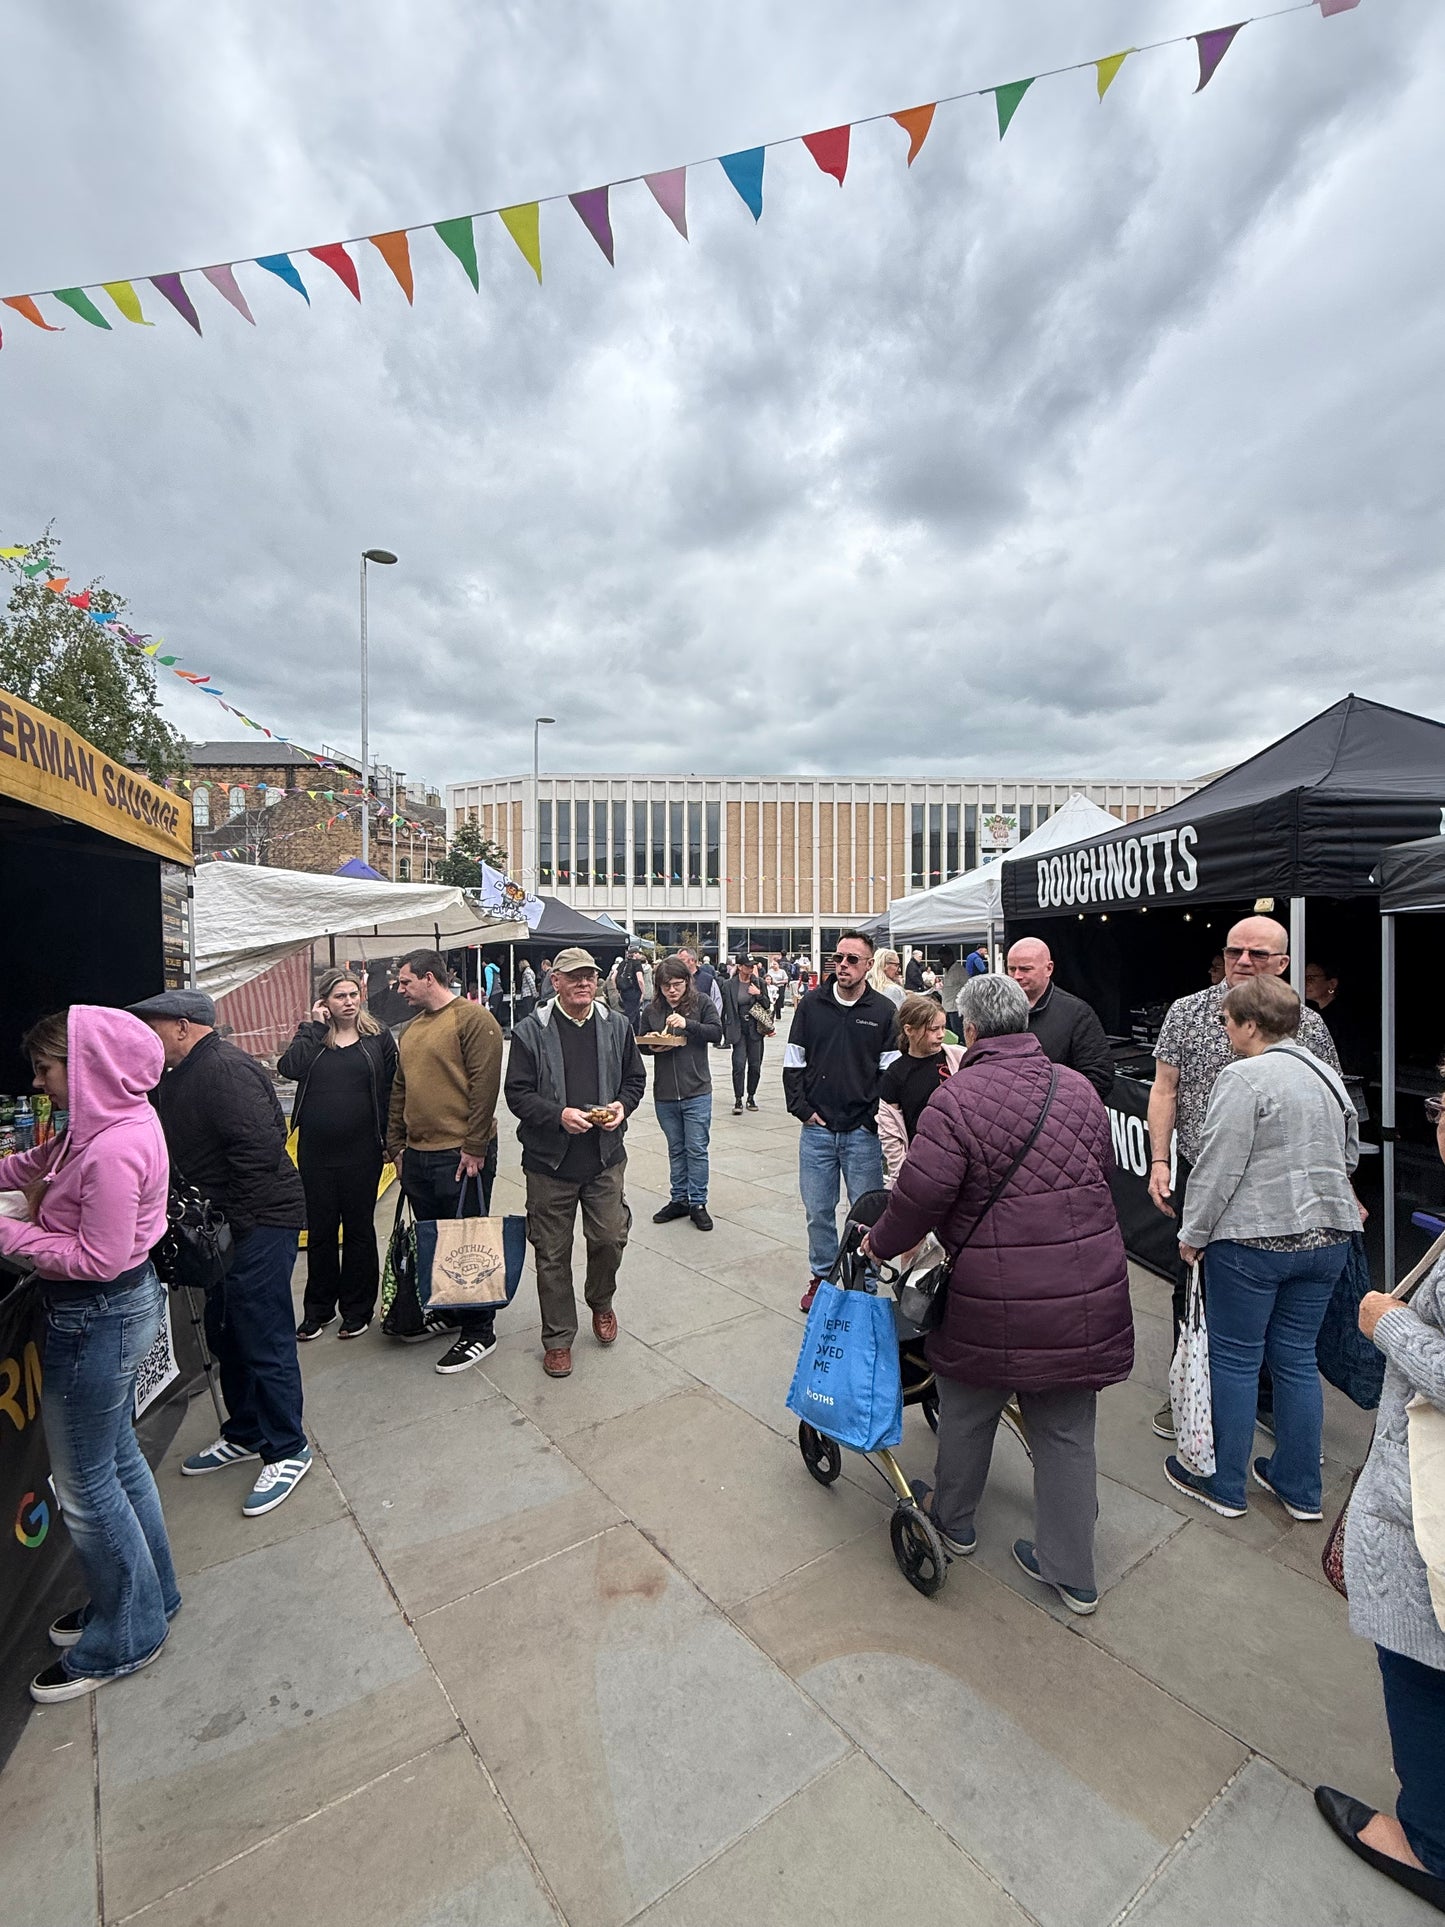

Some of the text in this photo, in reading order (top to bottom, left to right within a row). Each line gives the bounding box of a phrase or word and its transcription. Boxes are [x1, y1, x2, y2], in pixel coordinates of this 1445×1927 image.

[102, 763, 179, 837] SAUSAGE
[1037, 825, 1198, 908] DOUGHNOTTS
[445, 1244, 500, 1266] SOOTHILLS
[813, 1359, 831, 1374] ME
